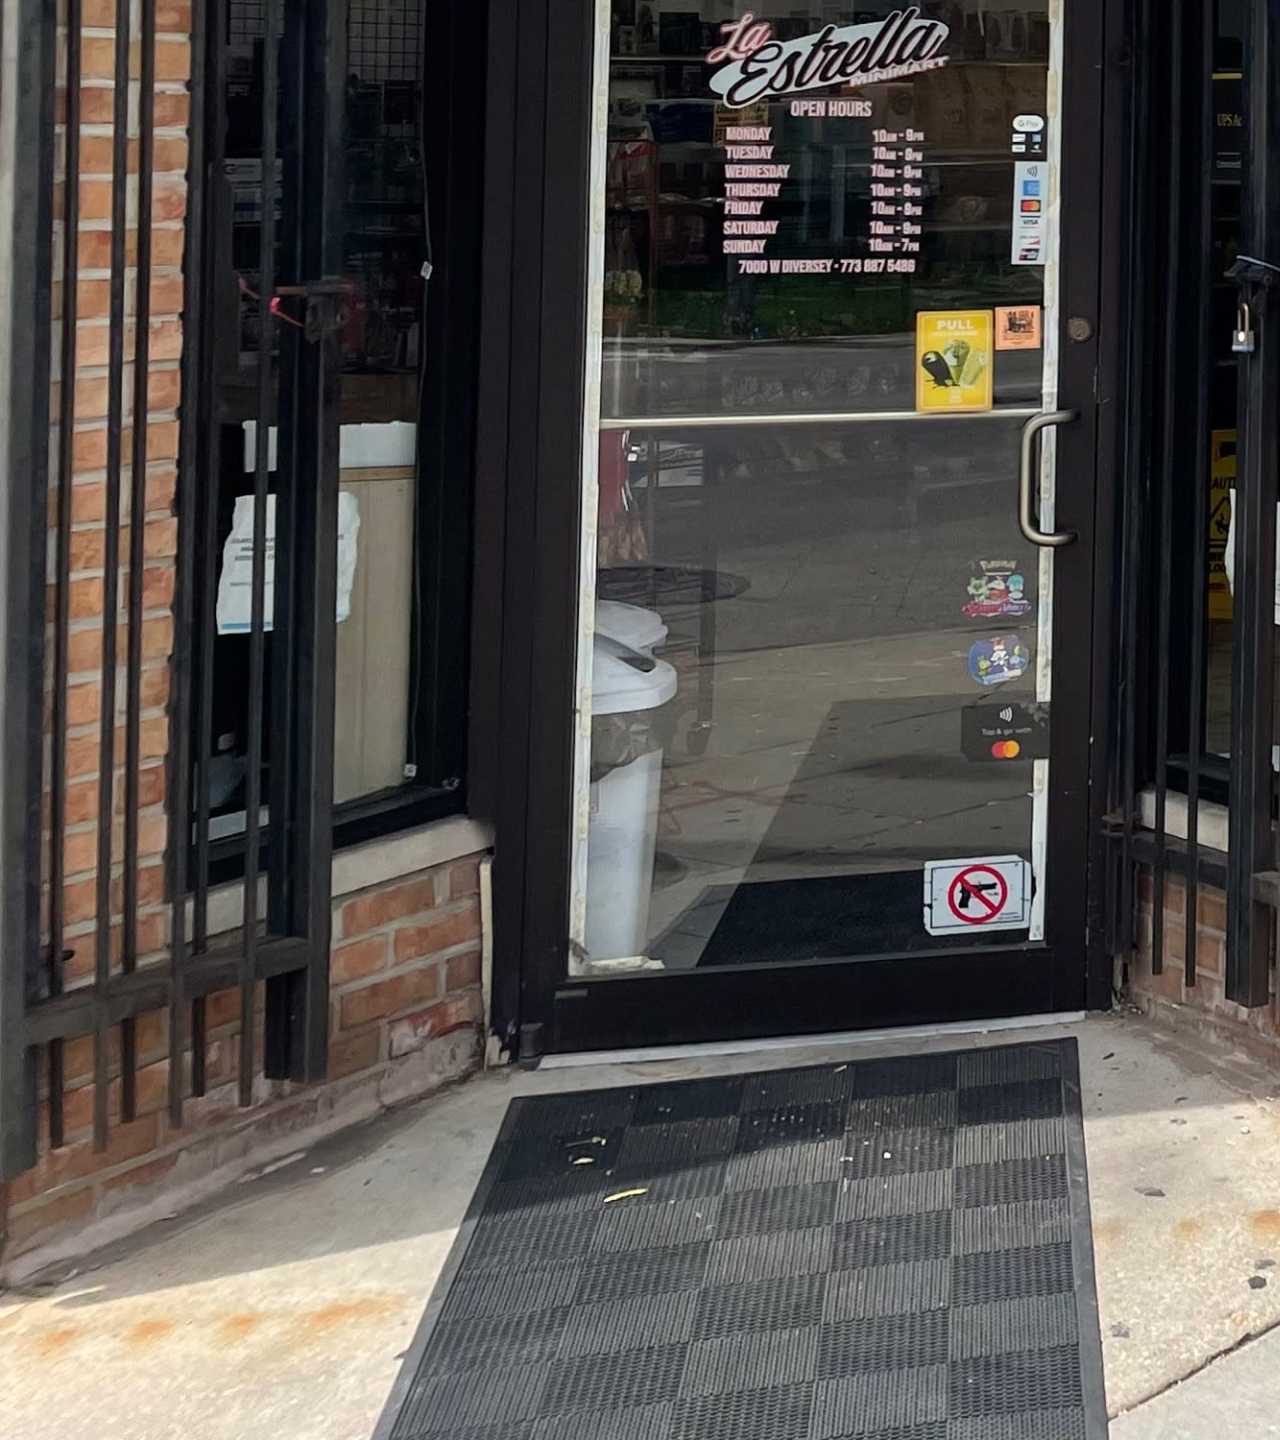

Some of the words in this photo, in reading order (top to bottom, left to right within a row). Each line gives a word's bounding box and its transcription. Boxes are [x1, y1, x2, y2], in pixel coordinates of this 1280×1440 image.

[706, 13, 772, 62] La
[725, 7, 943, 107] Estrella
[850, 56, 949, 87] MINIMART
[791, 101, 825, 117] OPEN
[829, 101, 872, 117] HOURS
[726, 127, 772, 141] MONDAY
[725, 146, 774, 160] TUESDAY
[724, 164, 790, 178] WEDNESDAY
[724, 183, 781, 197] THURSDAY
[724, 201, 764, 215] FRIDAY
[723, 220, 779, 235] SATURDAY
[723, 239, 767, 253] SUNDAY
[738, 260, 767, 274] 7000
[770, 260, 782, 273] W
[782, 259, 834, 273] DIVERSEY
[840, 259, 862, 273] 773
[937, 319, 975, 331] PULL
